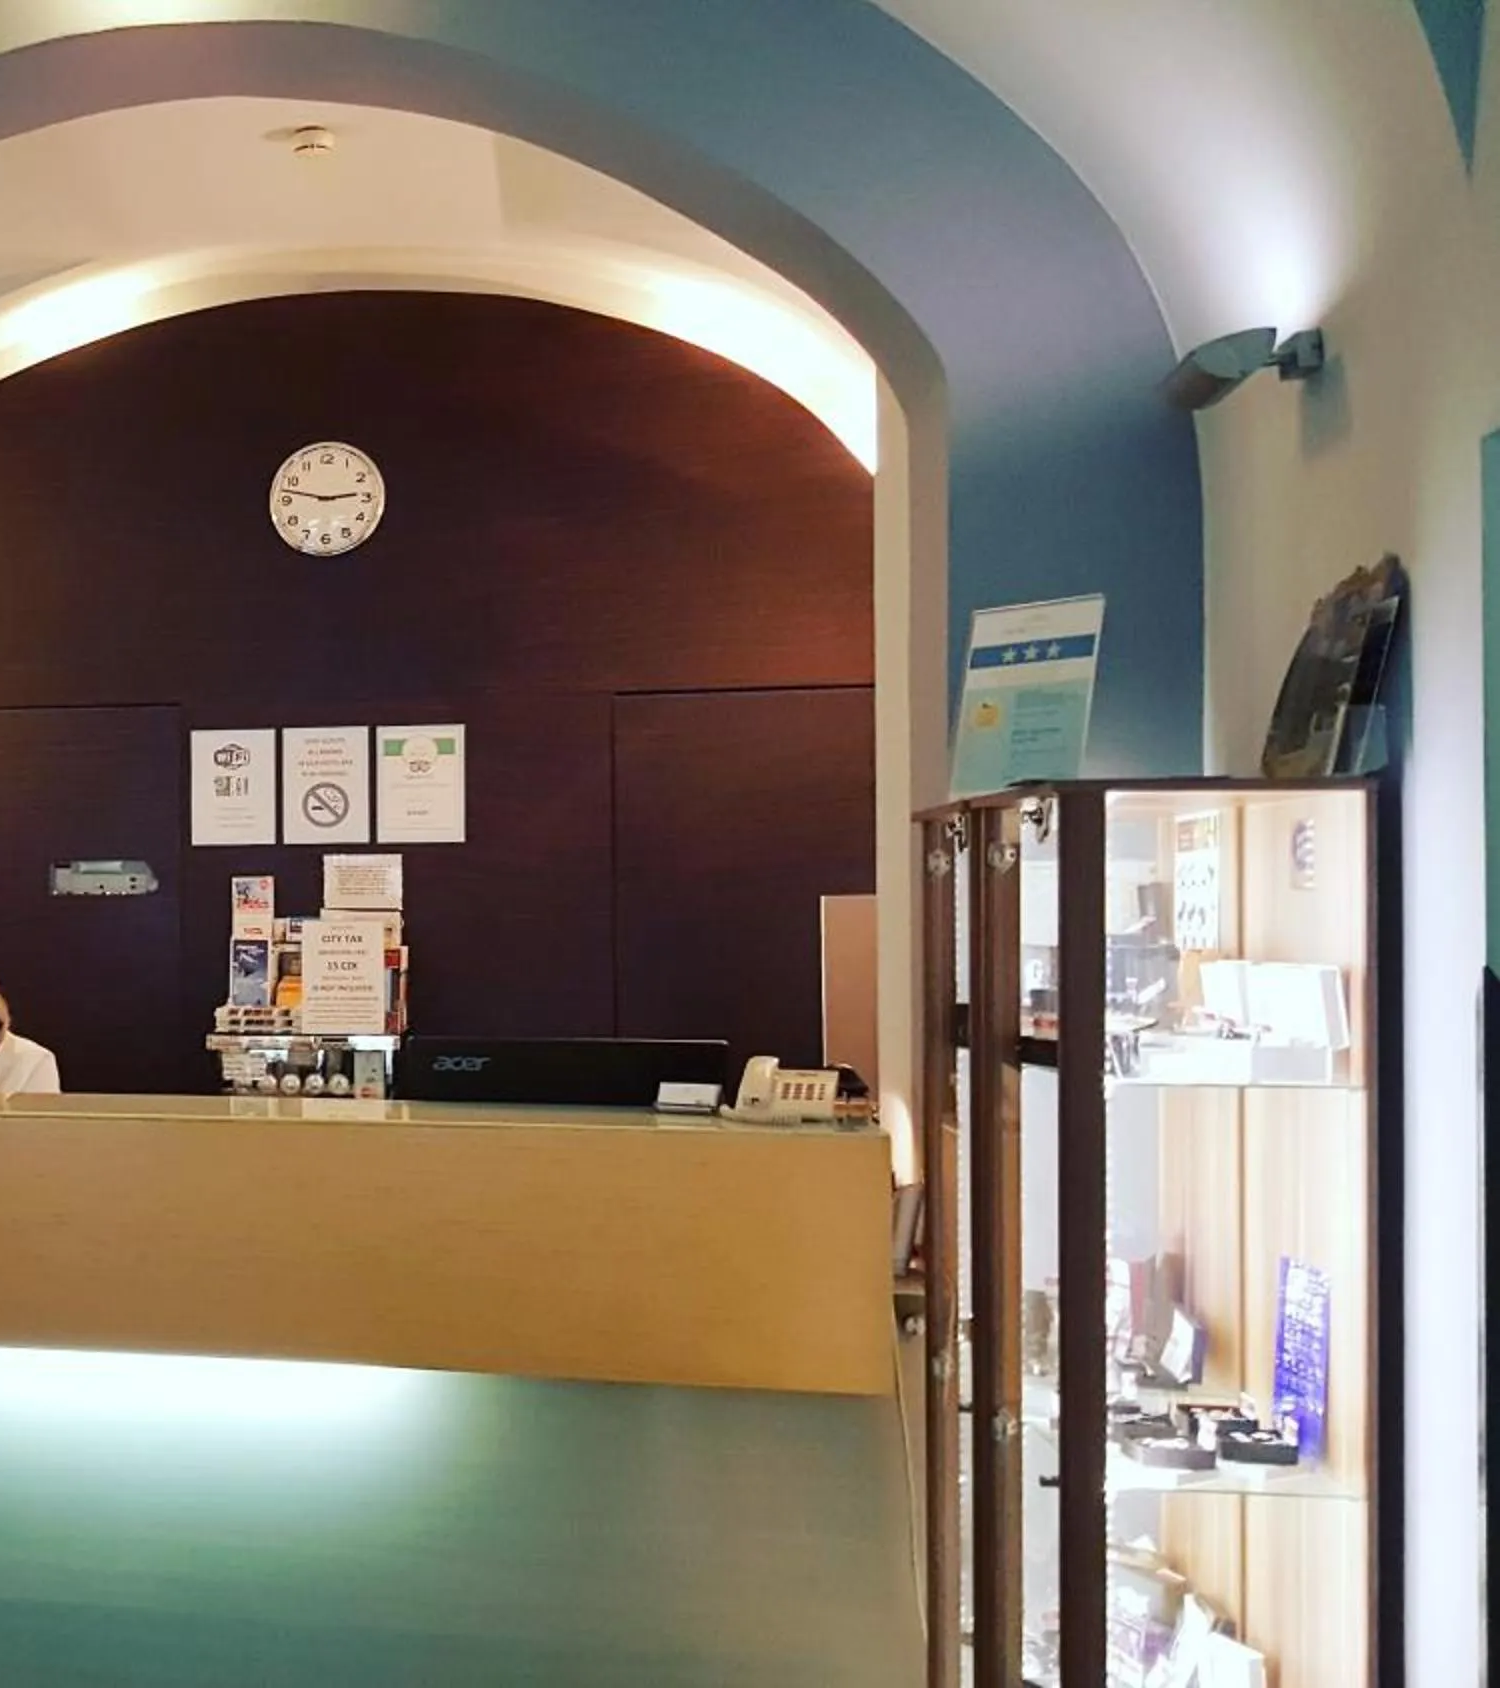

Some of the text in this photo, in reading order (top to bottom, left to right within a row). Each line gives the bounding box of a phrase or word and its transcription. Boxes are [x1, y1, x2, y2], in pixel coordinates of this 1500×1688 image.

[320, 454, 335, 465] 12
[302, 462, 311, 472] 11
[287, 476, 299, 487] 10
[356, 472, 366, 483] 2
[282, 496, 292, 506] 9
[361, 492, 372, 503] 3
[287, 516, 298, 526] 8
[356, 512, 365, 521] 4
[302, 529, 311, 540] 7
[320, 533, 331, 544] 6
[341, 528, 352, 538] 5
[321, 935, 342, 943] CITY
[432, 1056, 491, 1071] acer
